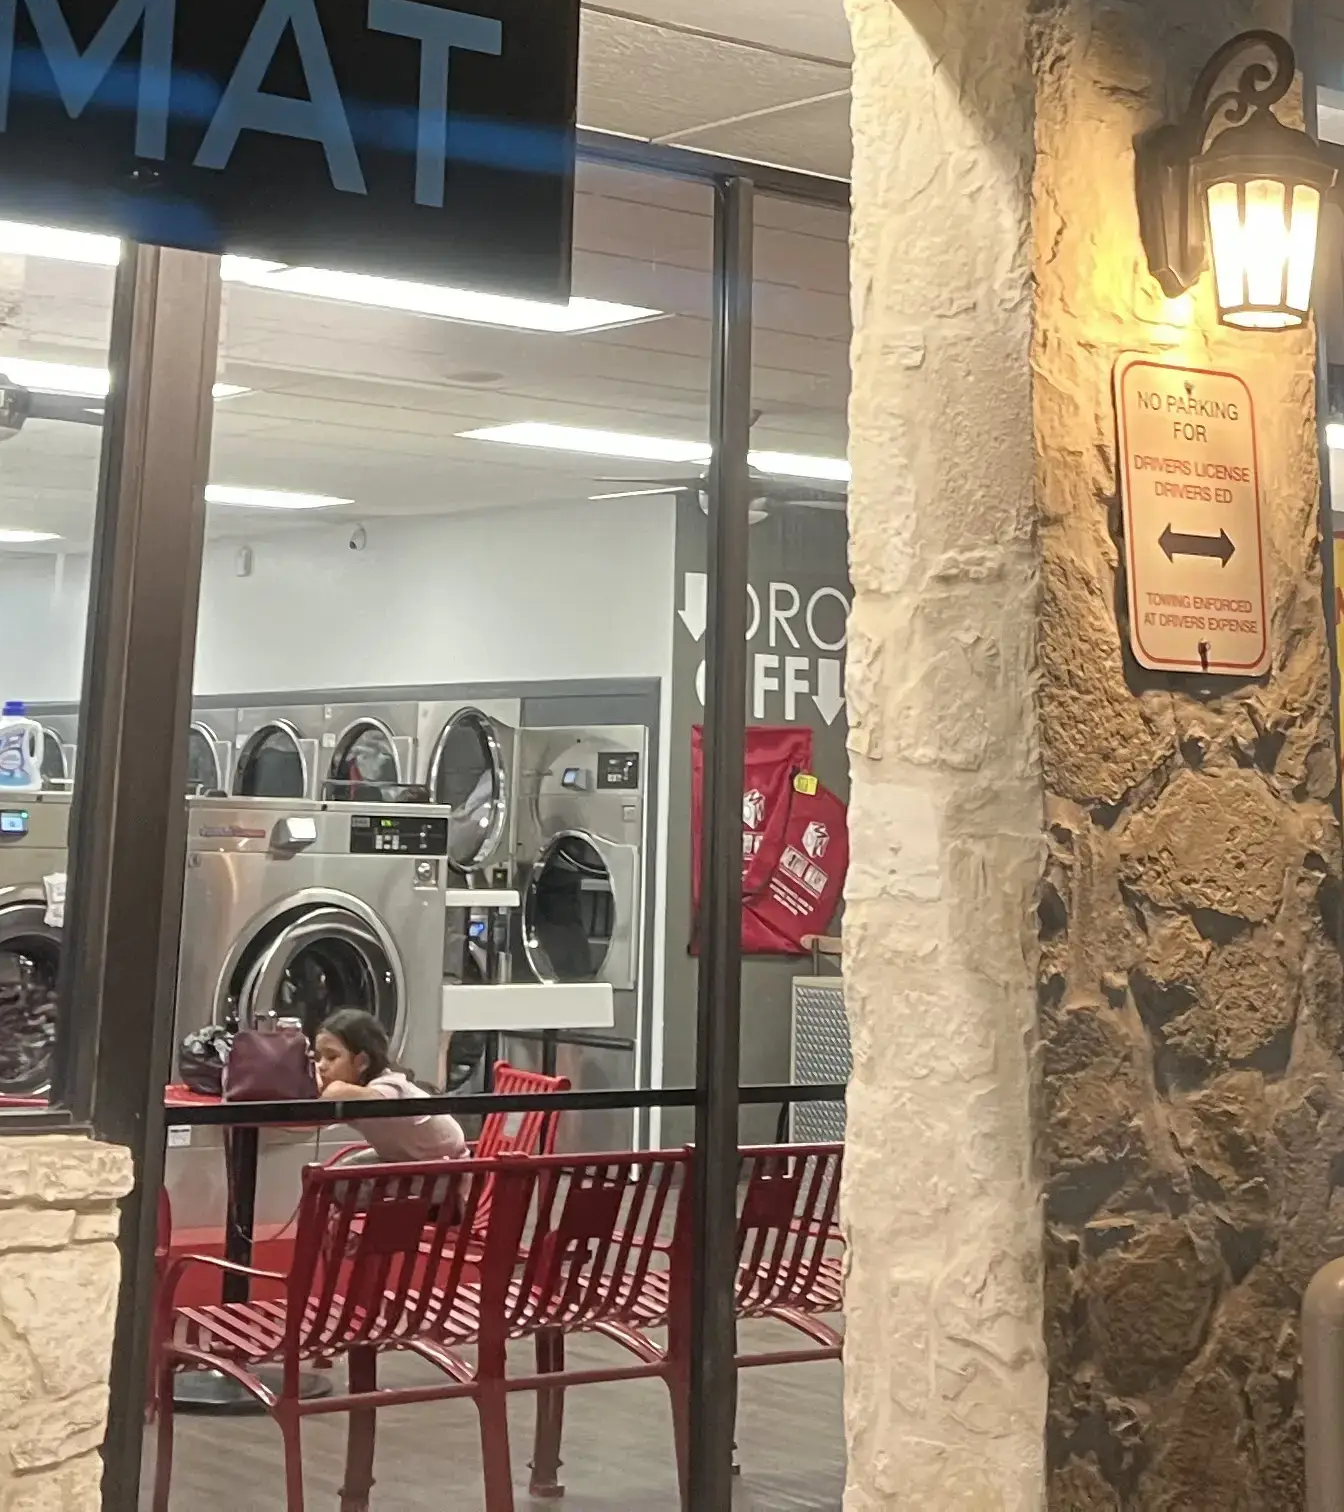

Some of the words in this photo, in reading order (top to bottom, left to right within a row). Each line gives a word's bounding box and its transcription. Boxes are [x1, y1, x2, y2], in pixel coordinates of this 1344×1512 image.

[1137, 391, 1162, 411] NO
[1166, 394, 1239, 422] PARKING
[1173, 421, 1208, 443] FOR
[1134, 454, 1192, 476] DRIVERS
[1195, 462, 1251, 483] LICENSE
[1154, 480, 1212, 502] DRIVERS
[1215, 487, 1233, 504] ED
[1146, 592, 1192, 609] TOWING
[1193, 596, 1253, 614] ENFORCED
[1144, 612, 1158, 626] AT
[1159, 613, 1206, 630] DRIVERS
[1207, 617, 1258, 634] EXPENSE
[695, 652, 810, 722] FF
